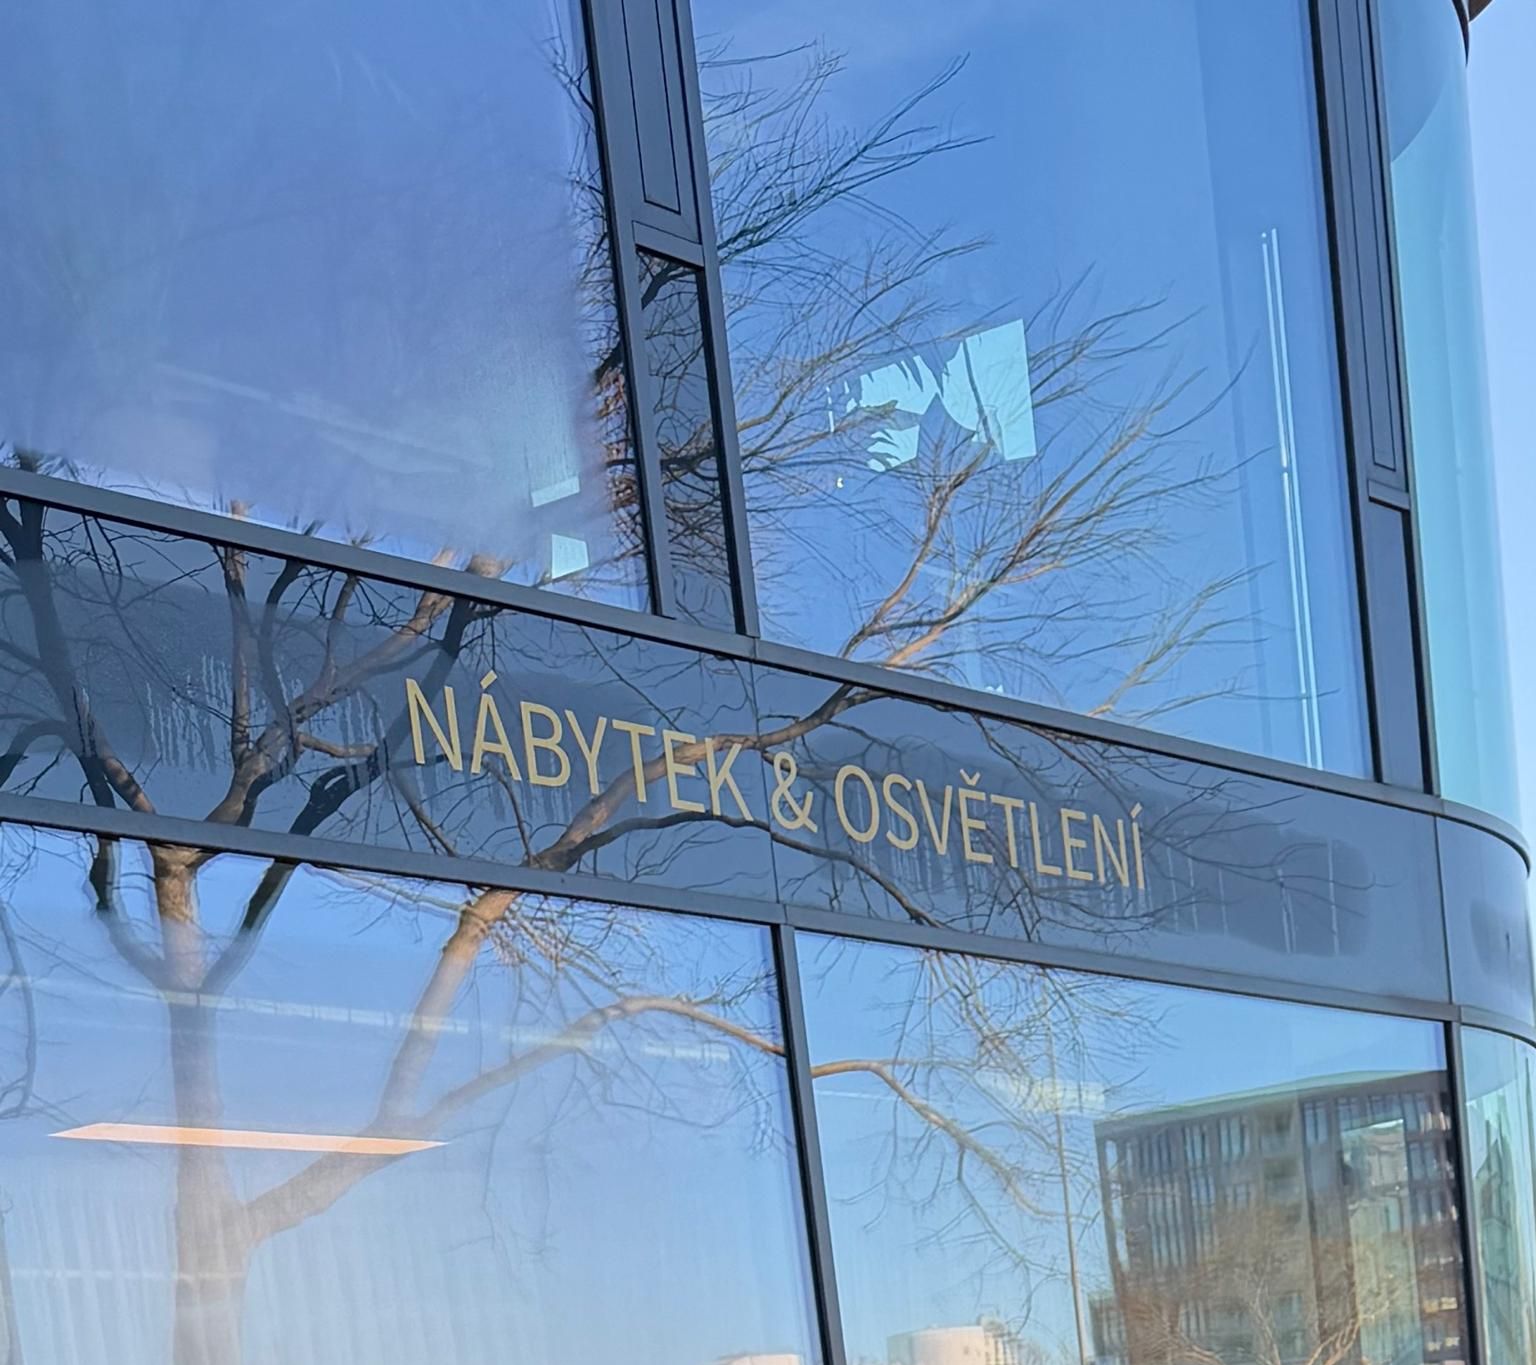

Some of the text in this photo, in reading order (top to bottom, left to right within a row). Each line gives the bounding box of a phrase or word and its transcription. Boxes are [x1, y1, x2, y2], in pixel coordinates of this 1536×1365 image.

[405, 670, 1145, 891] NÁBYTEK & OSVĚTLENÍ
